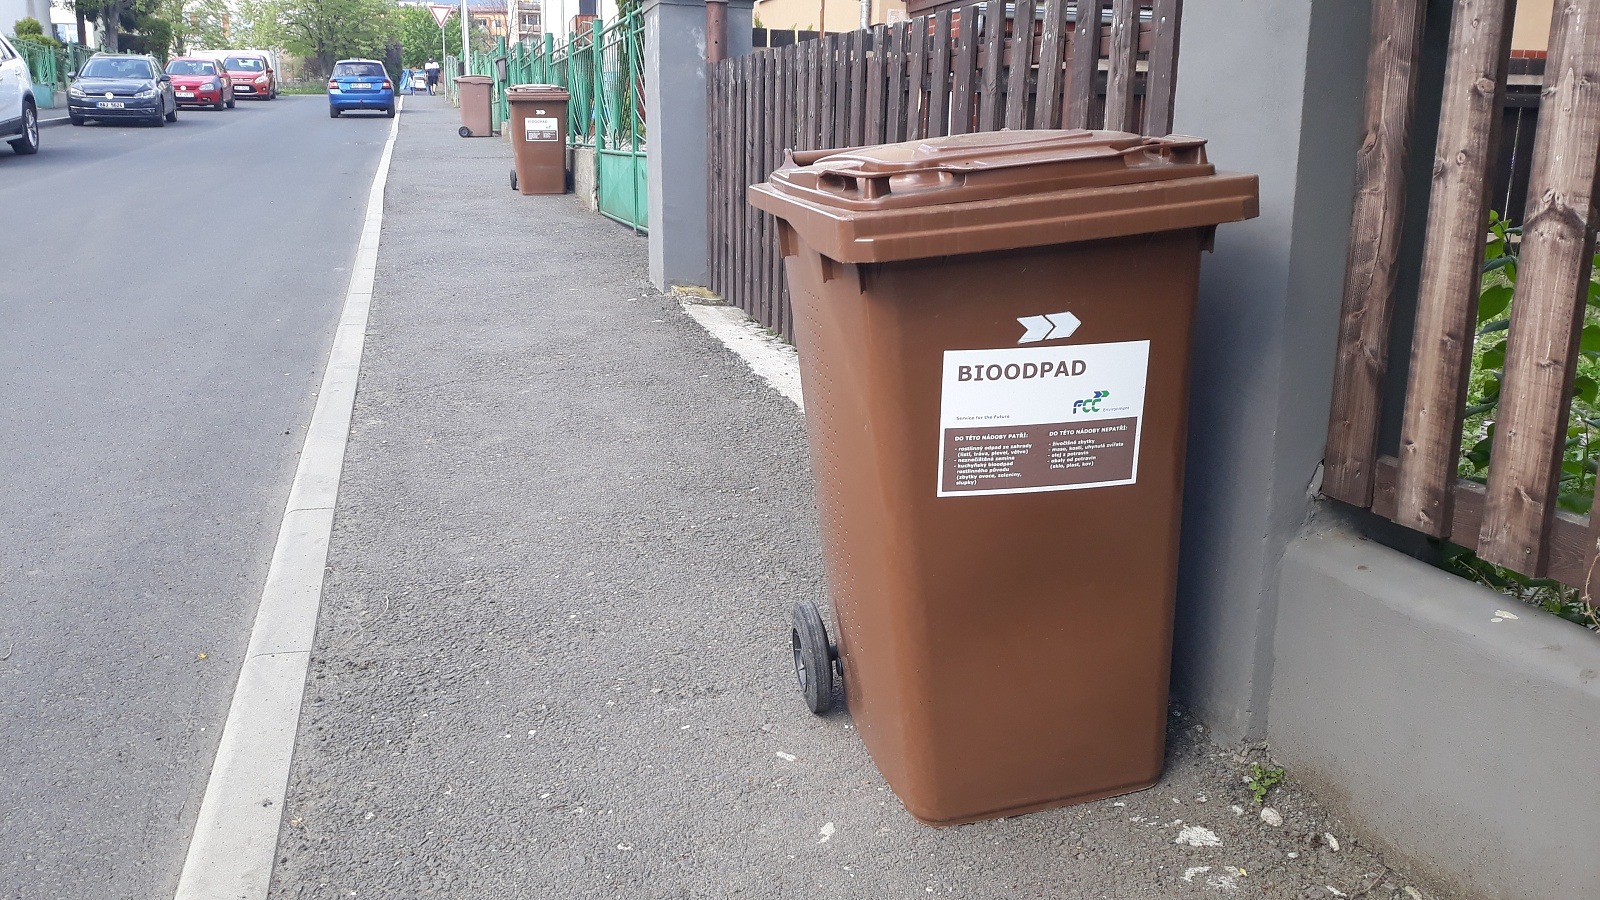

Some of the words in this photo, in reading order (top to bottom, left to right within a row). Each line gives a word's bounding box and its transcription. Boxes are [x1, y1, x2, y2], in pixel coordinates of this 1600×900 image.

[958, 360, 1087, 382] BIOODPAD
[1073, 398, 1102, 414] FCC
[1060, 428, 1074, 436] TÉTO
